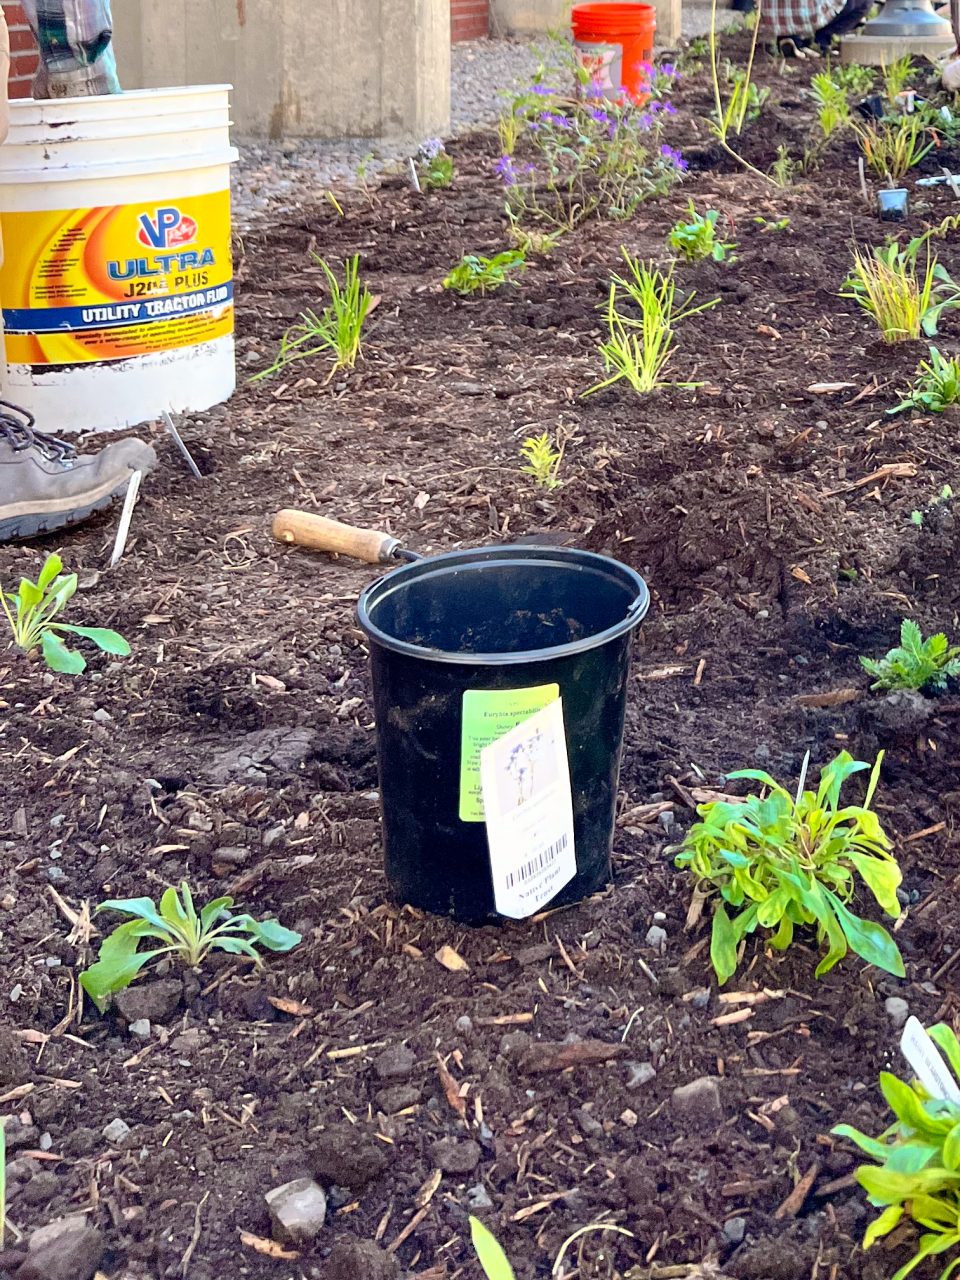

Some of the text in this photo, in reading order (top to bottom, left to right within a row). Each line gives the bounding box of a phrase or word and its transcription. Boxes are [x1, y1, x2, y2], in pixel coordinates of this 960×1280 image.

[139, 208, 180, 249] VP
[107, 247, 217, 281] ULTRA
[175, 271, 209, 289] PLUS
[82, 286, 228, 322] UTILITY TRACTOR FLUID
